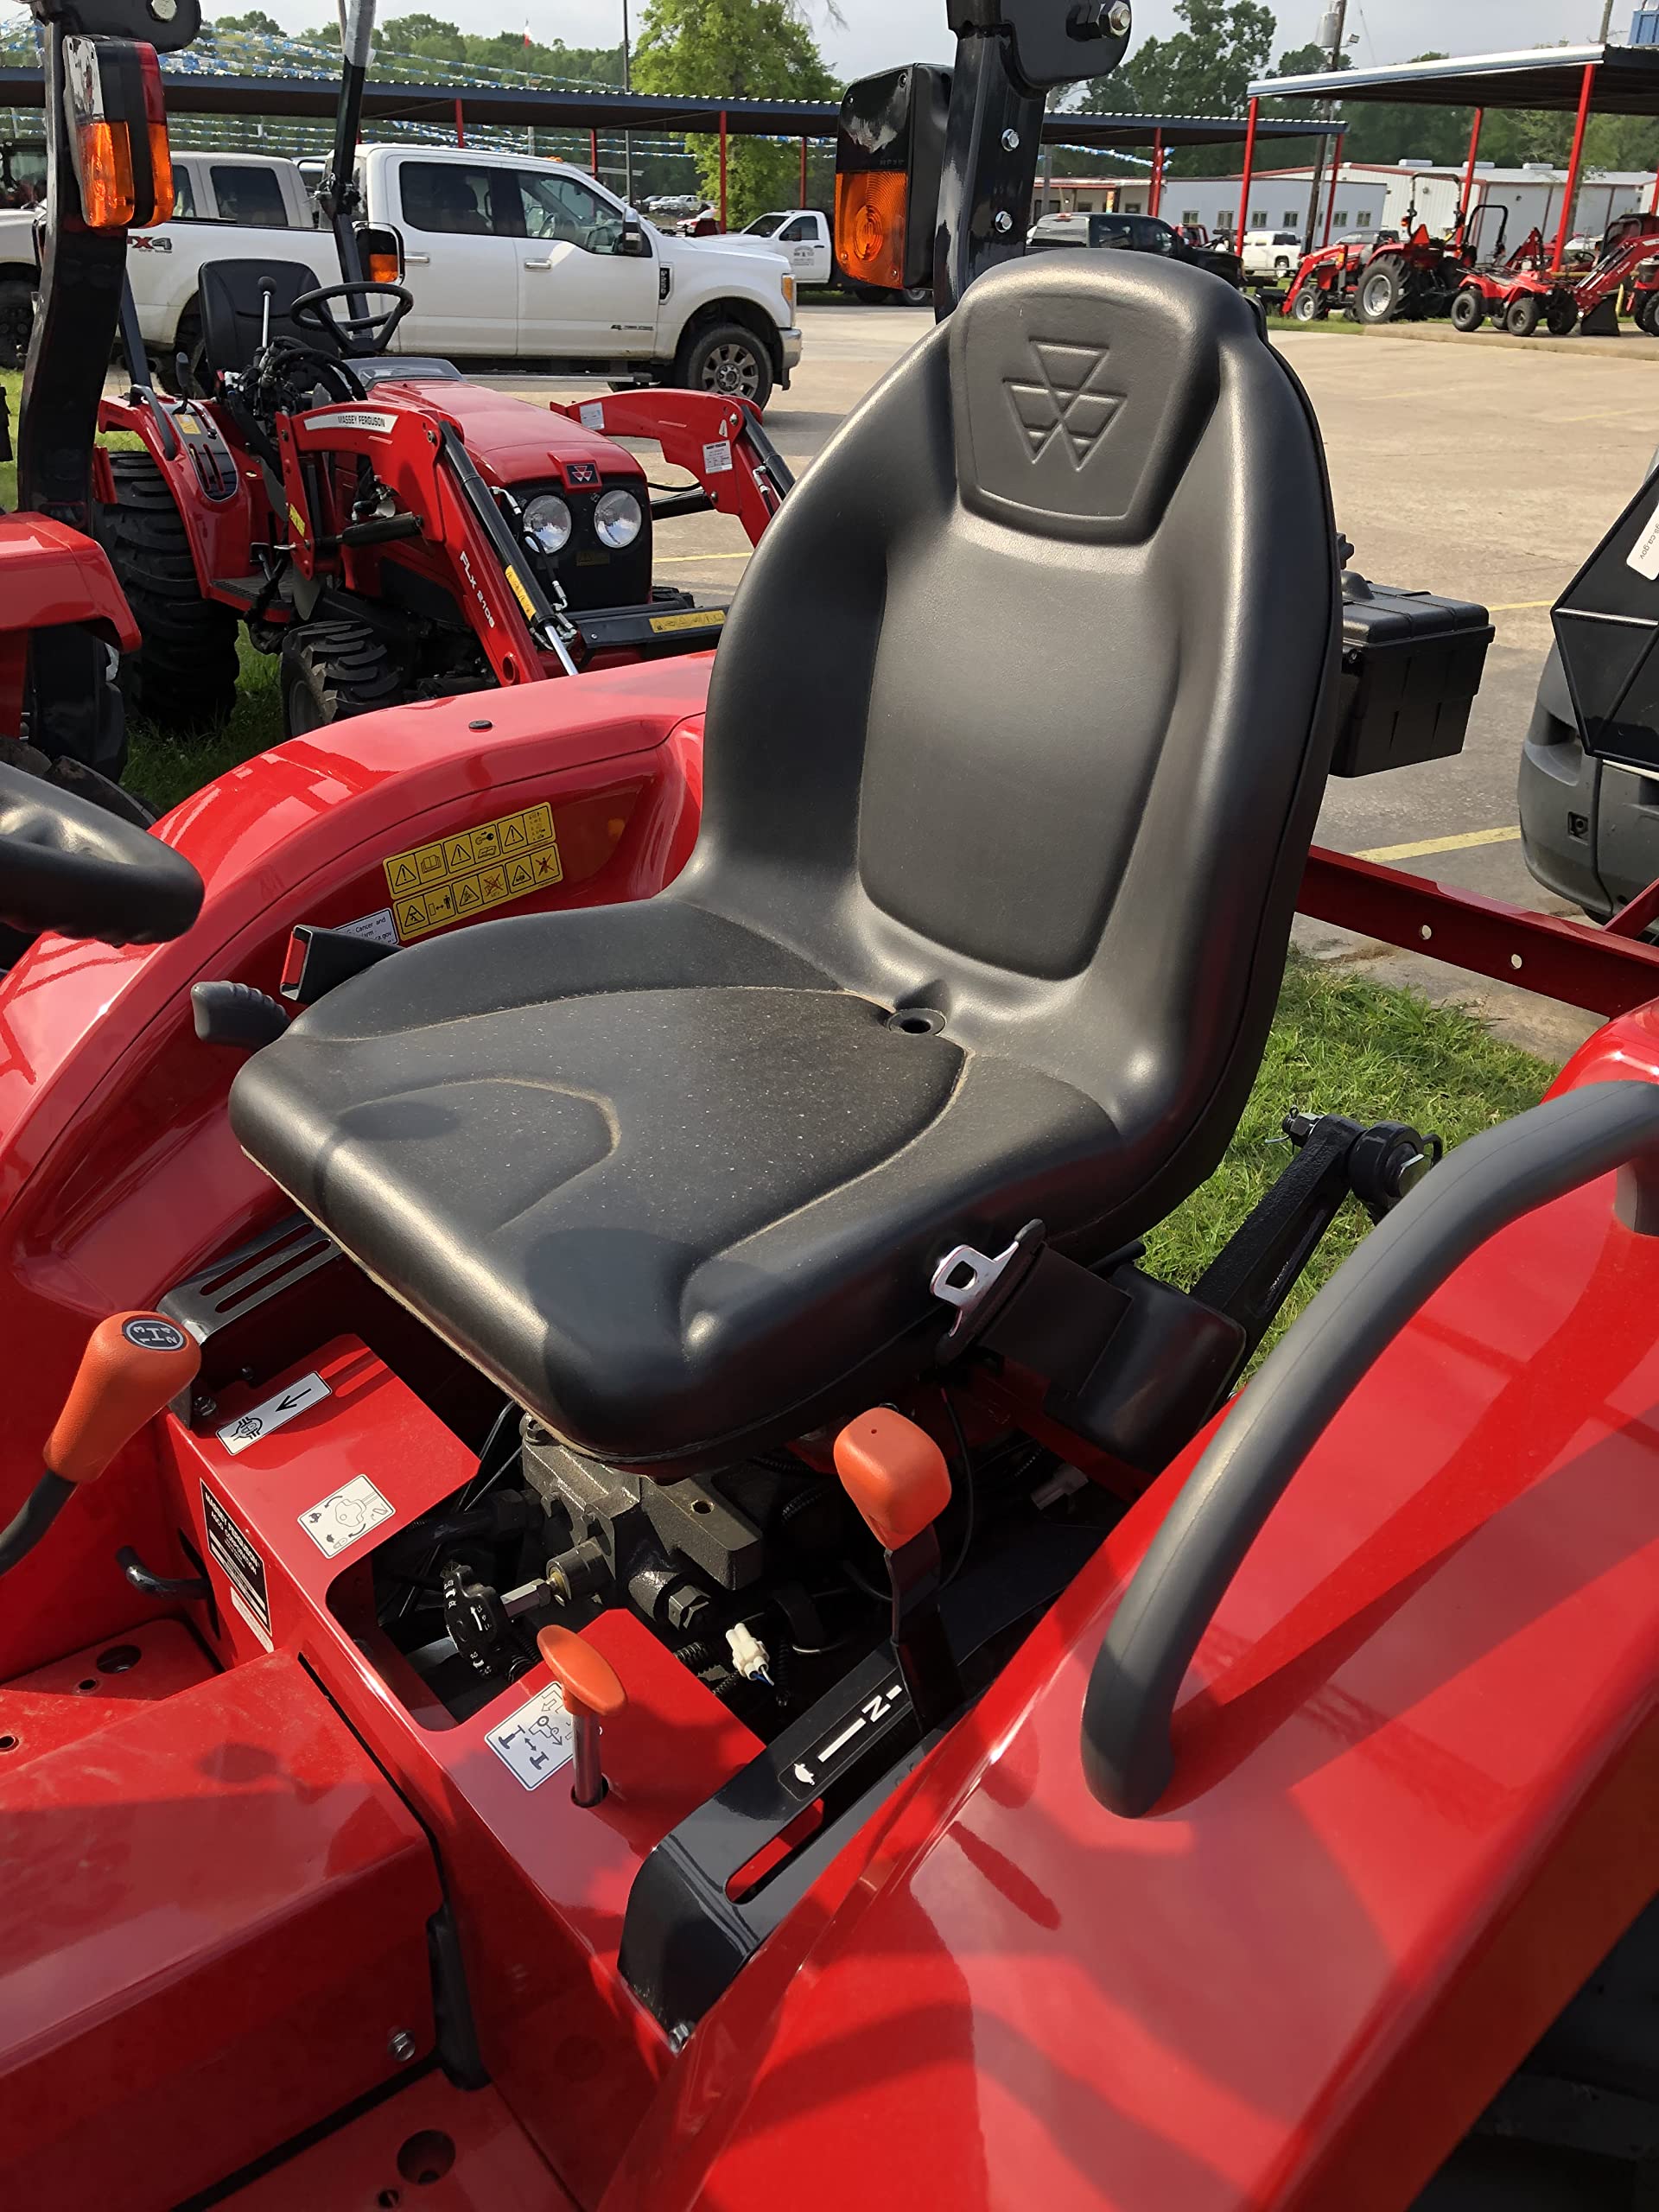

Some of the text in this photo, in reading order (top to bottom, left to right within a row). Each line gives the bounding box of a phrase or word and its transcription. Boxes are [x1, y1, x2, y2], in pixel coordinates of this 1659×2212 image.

[127, 236, 172, 250] X4
[359, 416, 385, 427] FERGUSON
[355, 922, 373, 933] Cancer
[376, 917, 386, 925] and
[861, 1694, 892, 1723] N
